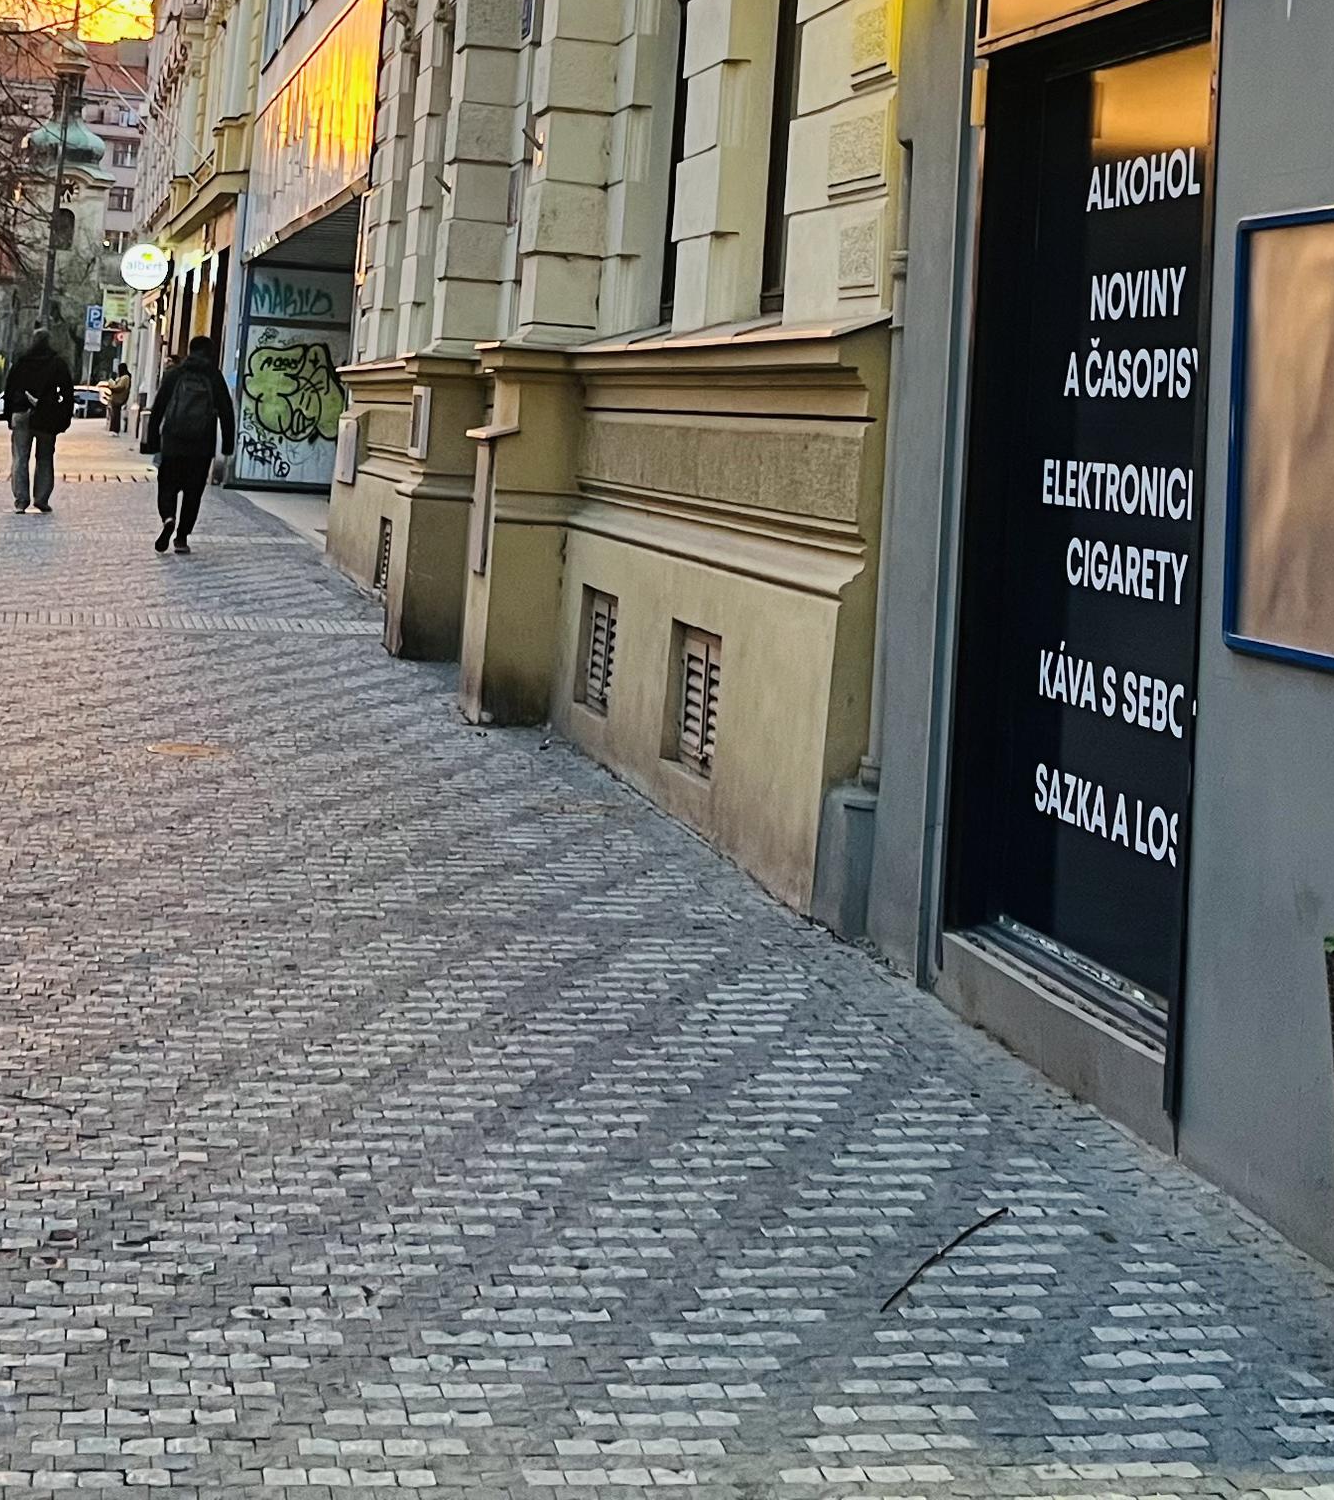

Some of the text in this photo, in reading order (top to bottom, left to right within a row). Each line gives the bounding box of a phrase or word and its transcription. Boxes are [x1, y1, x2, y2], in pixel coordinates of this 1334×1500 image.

[1085, 146, 1201, 213] ALKOHOL
[1090, 266, 1187, 322] NOVINY
[1063, 351, 1080, 397] A
[1066, 536, 1189, 606] CIGARETY
[1038, 640, 1097, 713] KÁVA
[1101, 665, 1117, 718] S
[1034, 762, 1108, 840] SAZKA
[1110, 792, 1130, 849] A
